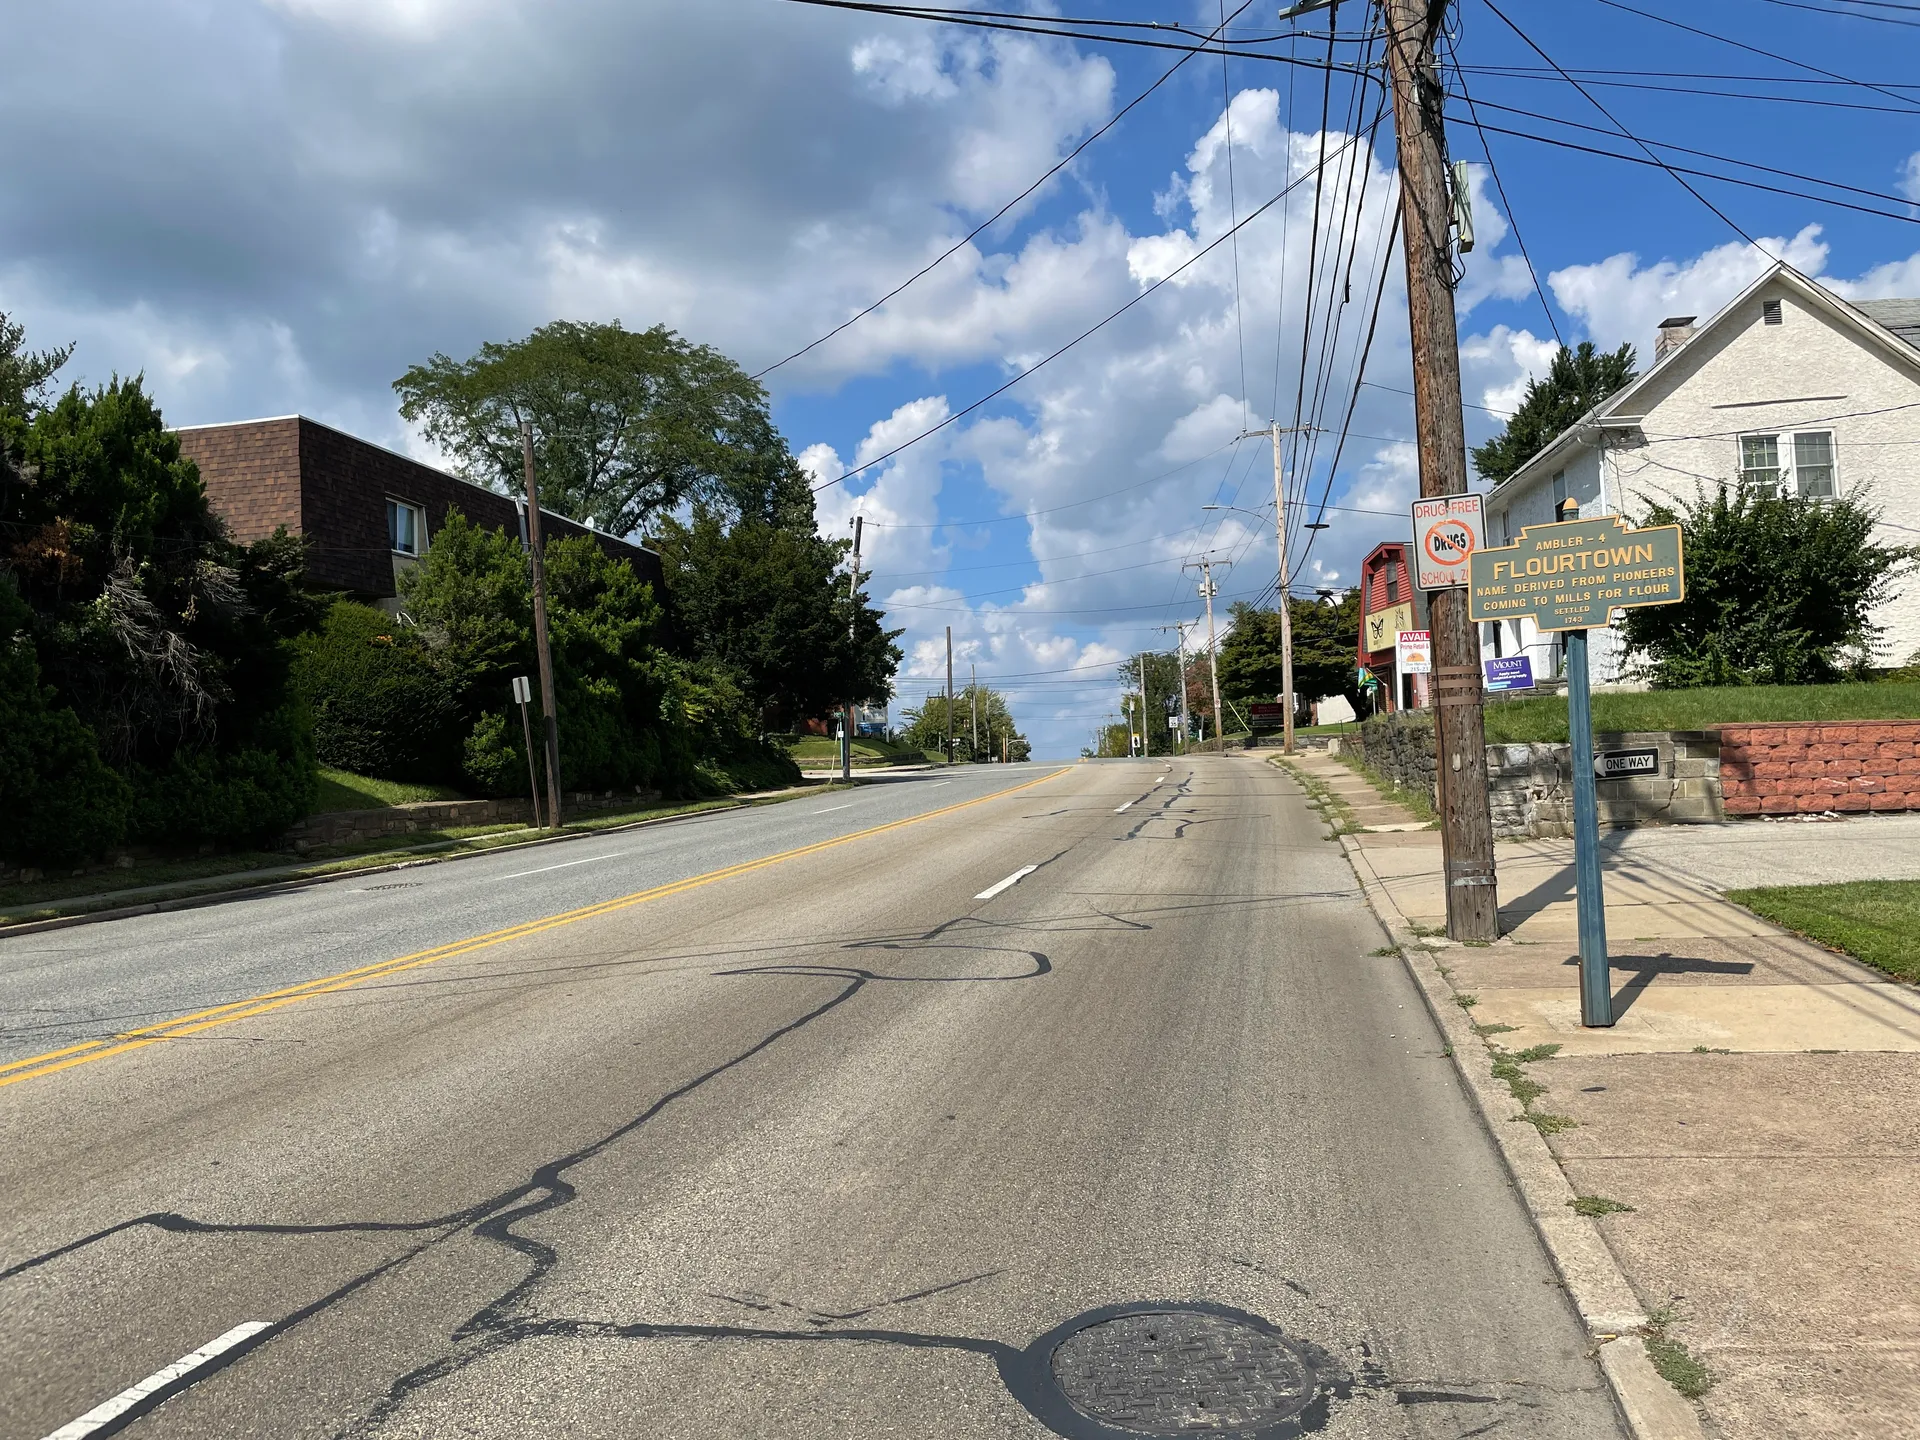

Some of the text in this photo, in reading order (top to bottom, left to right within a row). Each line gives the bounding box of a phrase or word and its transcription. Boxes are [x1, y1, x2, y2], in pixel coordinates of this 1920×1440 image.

[1415, 499, 1479, 518] DRUG-FREE
[1433, 532, 1467, 551] DRUGS
[1535, 536, 1583, 551] AMBLER
[1598, 533, 1606, 543] 4
[1493, 543, 1653, 580] FLOURTOWN
[1421, 569, 1457, 586] SCHOOL
[1476, 566, 1675, 597] NAME DERIVED FROM PIONEERS
[1483, 583, 1670, 611] COMING TO MILLS FOR FLOUR
[1554, 605, 1590, 615] SETTLED
[1564, 616, 1583, 624] 1743
[1493, 660, 1523, 670] MOUNT
[1606, 756, 1650, 770] ONE WAY
